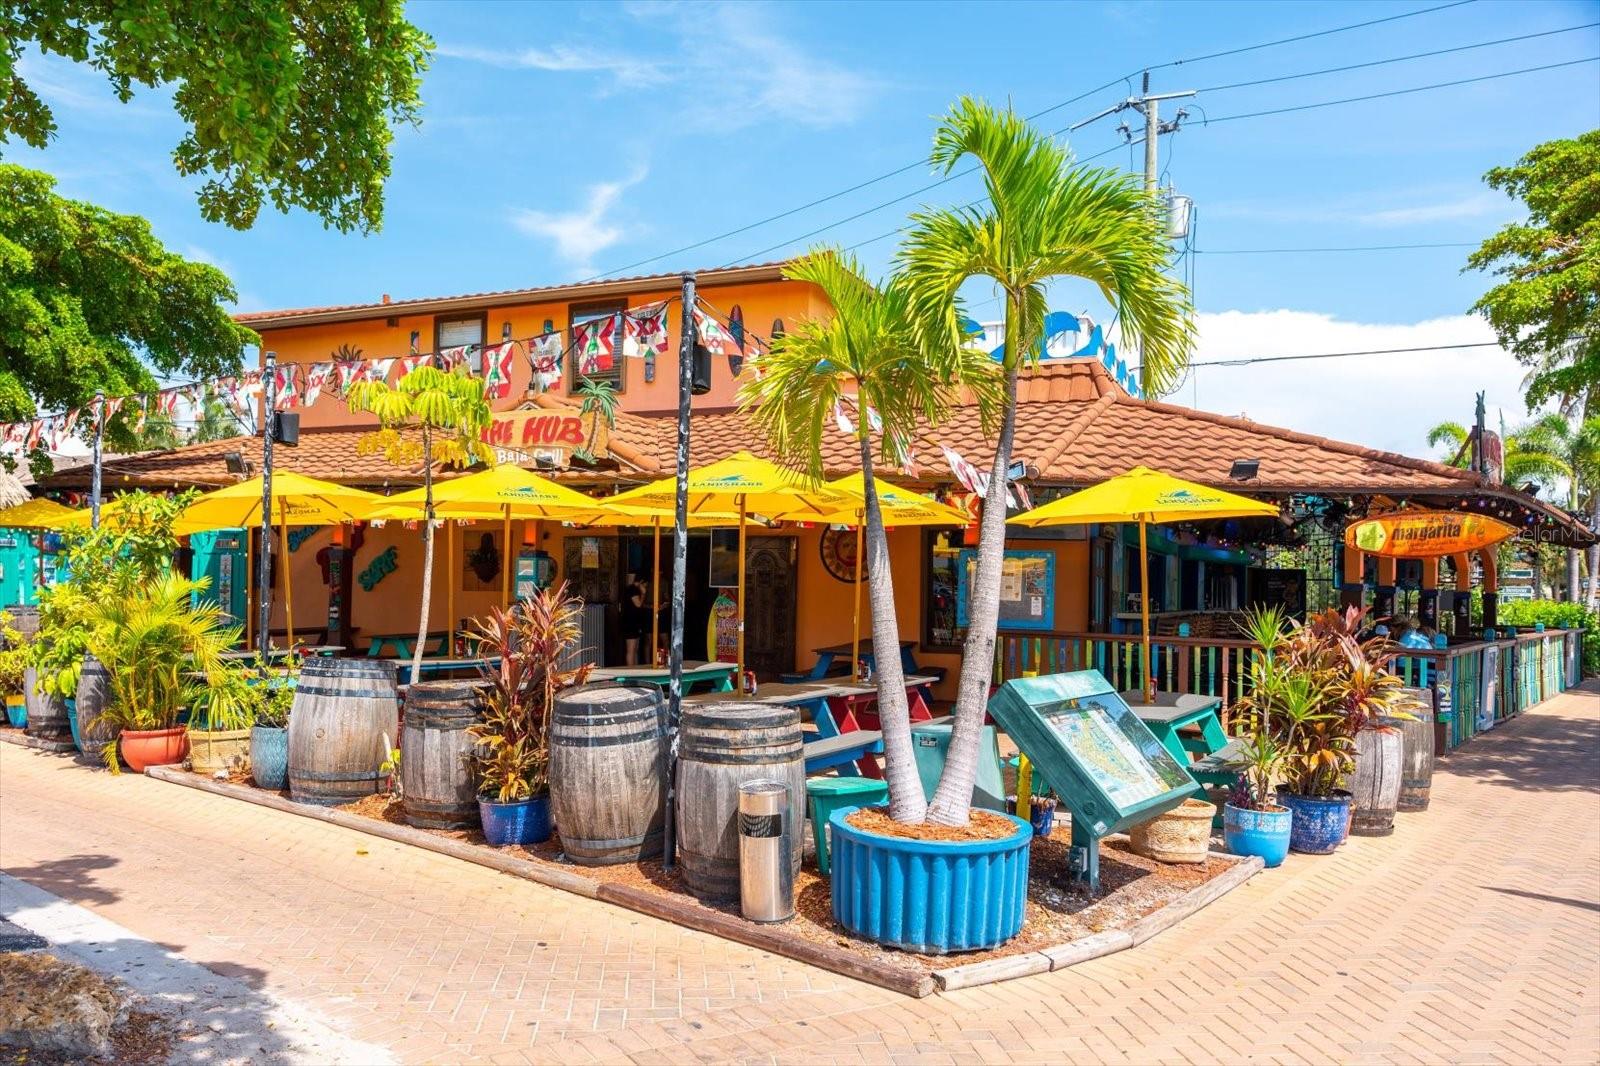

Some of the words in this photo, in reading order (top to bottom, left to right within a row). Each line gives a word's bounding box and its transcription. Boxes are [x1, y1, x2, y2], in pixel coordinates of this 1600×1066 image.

[636, 314, 662, 338] XX
[522, 415, 584, 445] HUB
[496, 449, 529, 465] Baja
[496, 491, 561, 500] LANDSHARK
[1391, 523, 1462, 541] margarita
